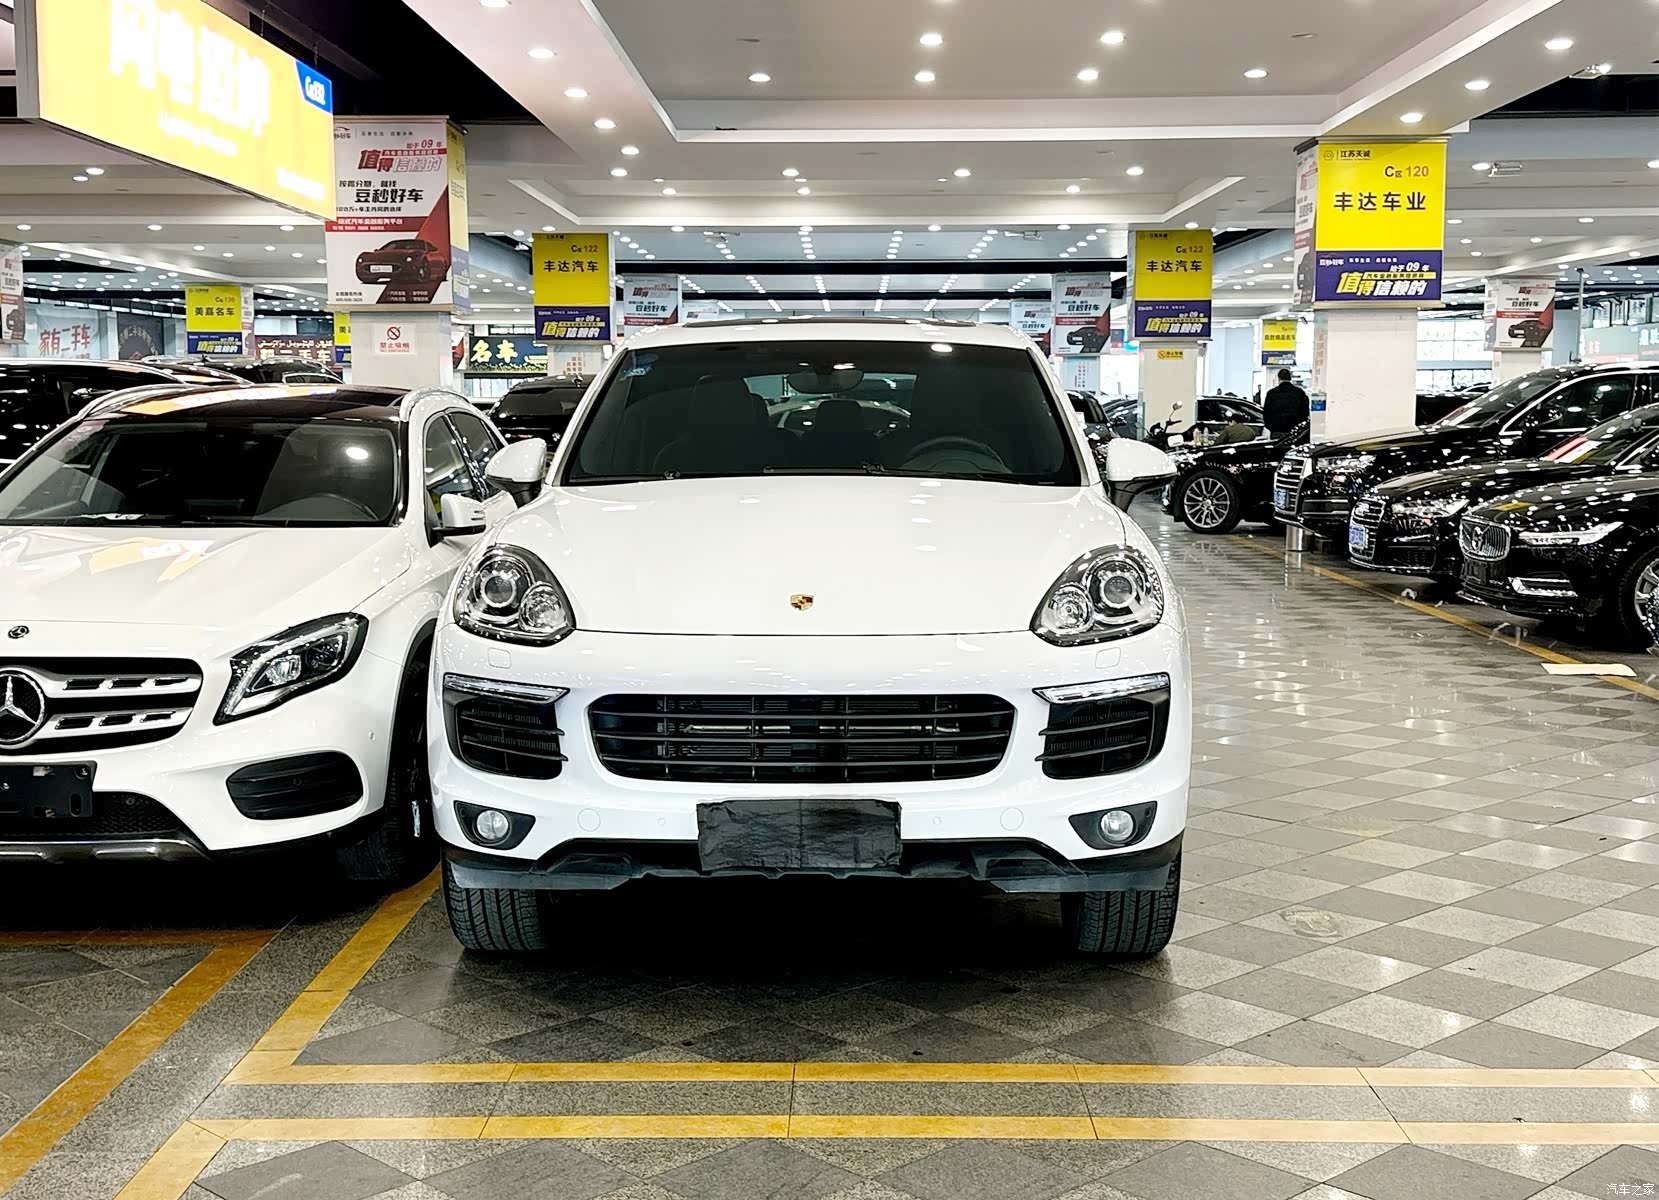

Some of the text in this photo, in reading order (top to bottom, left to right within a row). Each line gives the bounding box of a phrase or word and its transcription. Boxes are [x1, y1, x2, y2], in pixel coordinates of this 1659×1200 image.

[358, 149, 443, 172] 值得信赖的
[1406, 166, 1429, 177] 120
[354, 188, 424, 204] 豆秒好车
[1333, 192, 1426, 211] 丰达车业
[584, 244, 598, 253] 122
[1189, 245, 1204, 253] 122
[543, 260, 599, 272] 丰达汽车
[1146, 260, 1203, 272] 丰达汽车
[1336, 271, 1428, 296] 值得信赖的
